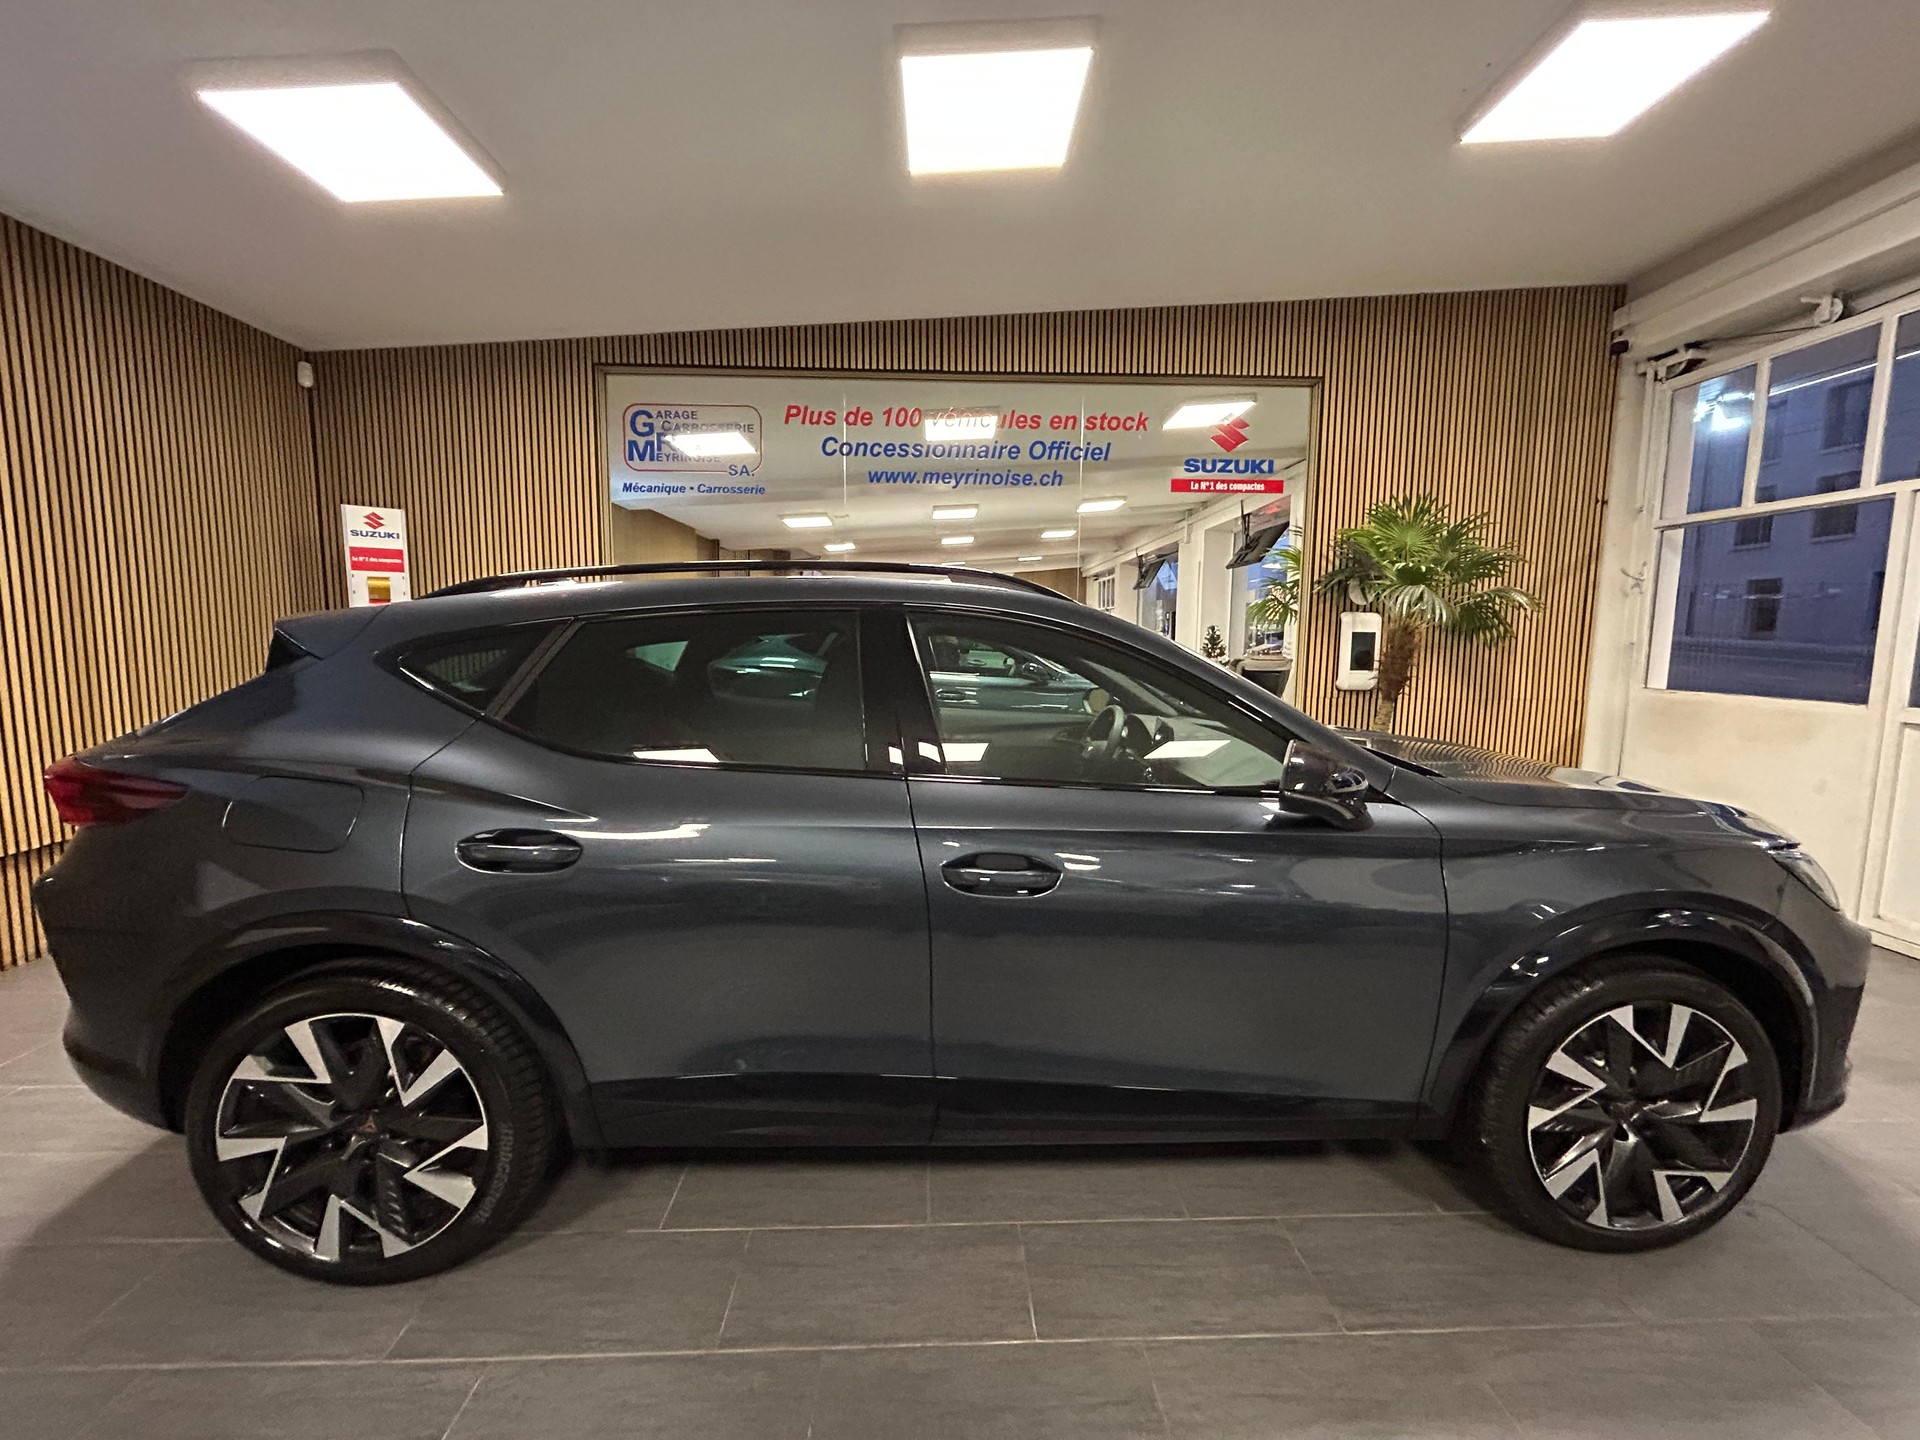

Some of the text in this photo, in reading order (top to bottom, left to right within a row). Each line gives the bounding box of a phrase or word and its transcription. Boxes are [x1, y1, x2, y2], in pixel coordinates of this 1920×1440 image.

[784, 405, 837, 426] Plus
[844, 407, 873, 427] de
[883, 407, 923, 427] 100
[1050, 414, 1078, 430] en
[1085, 411, 1149, 431] stock
[821, 436, 1111, 461] Concessionnaire Officiel
[1184, 458, 1274, 474] SUZUKI
[867, 468, 1063, 489] www.meyrinoise.ch
[1190, 481, 1200, 490] Le
[1215, 481, 1228, 491] des
[1229, 482, 1265, 492] compactes
[622, 482, 766, 496] Mécanique Carrosserie
[350, 529, 400, 540] SUZUKI
